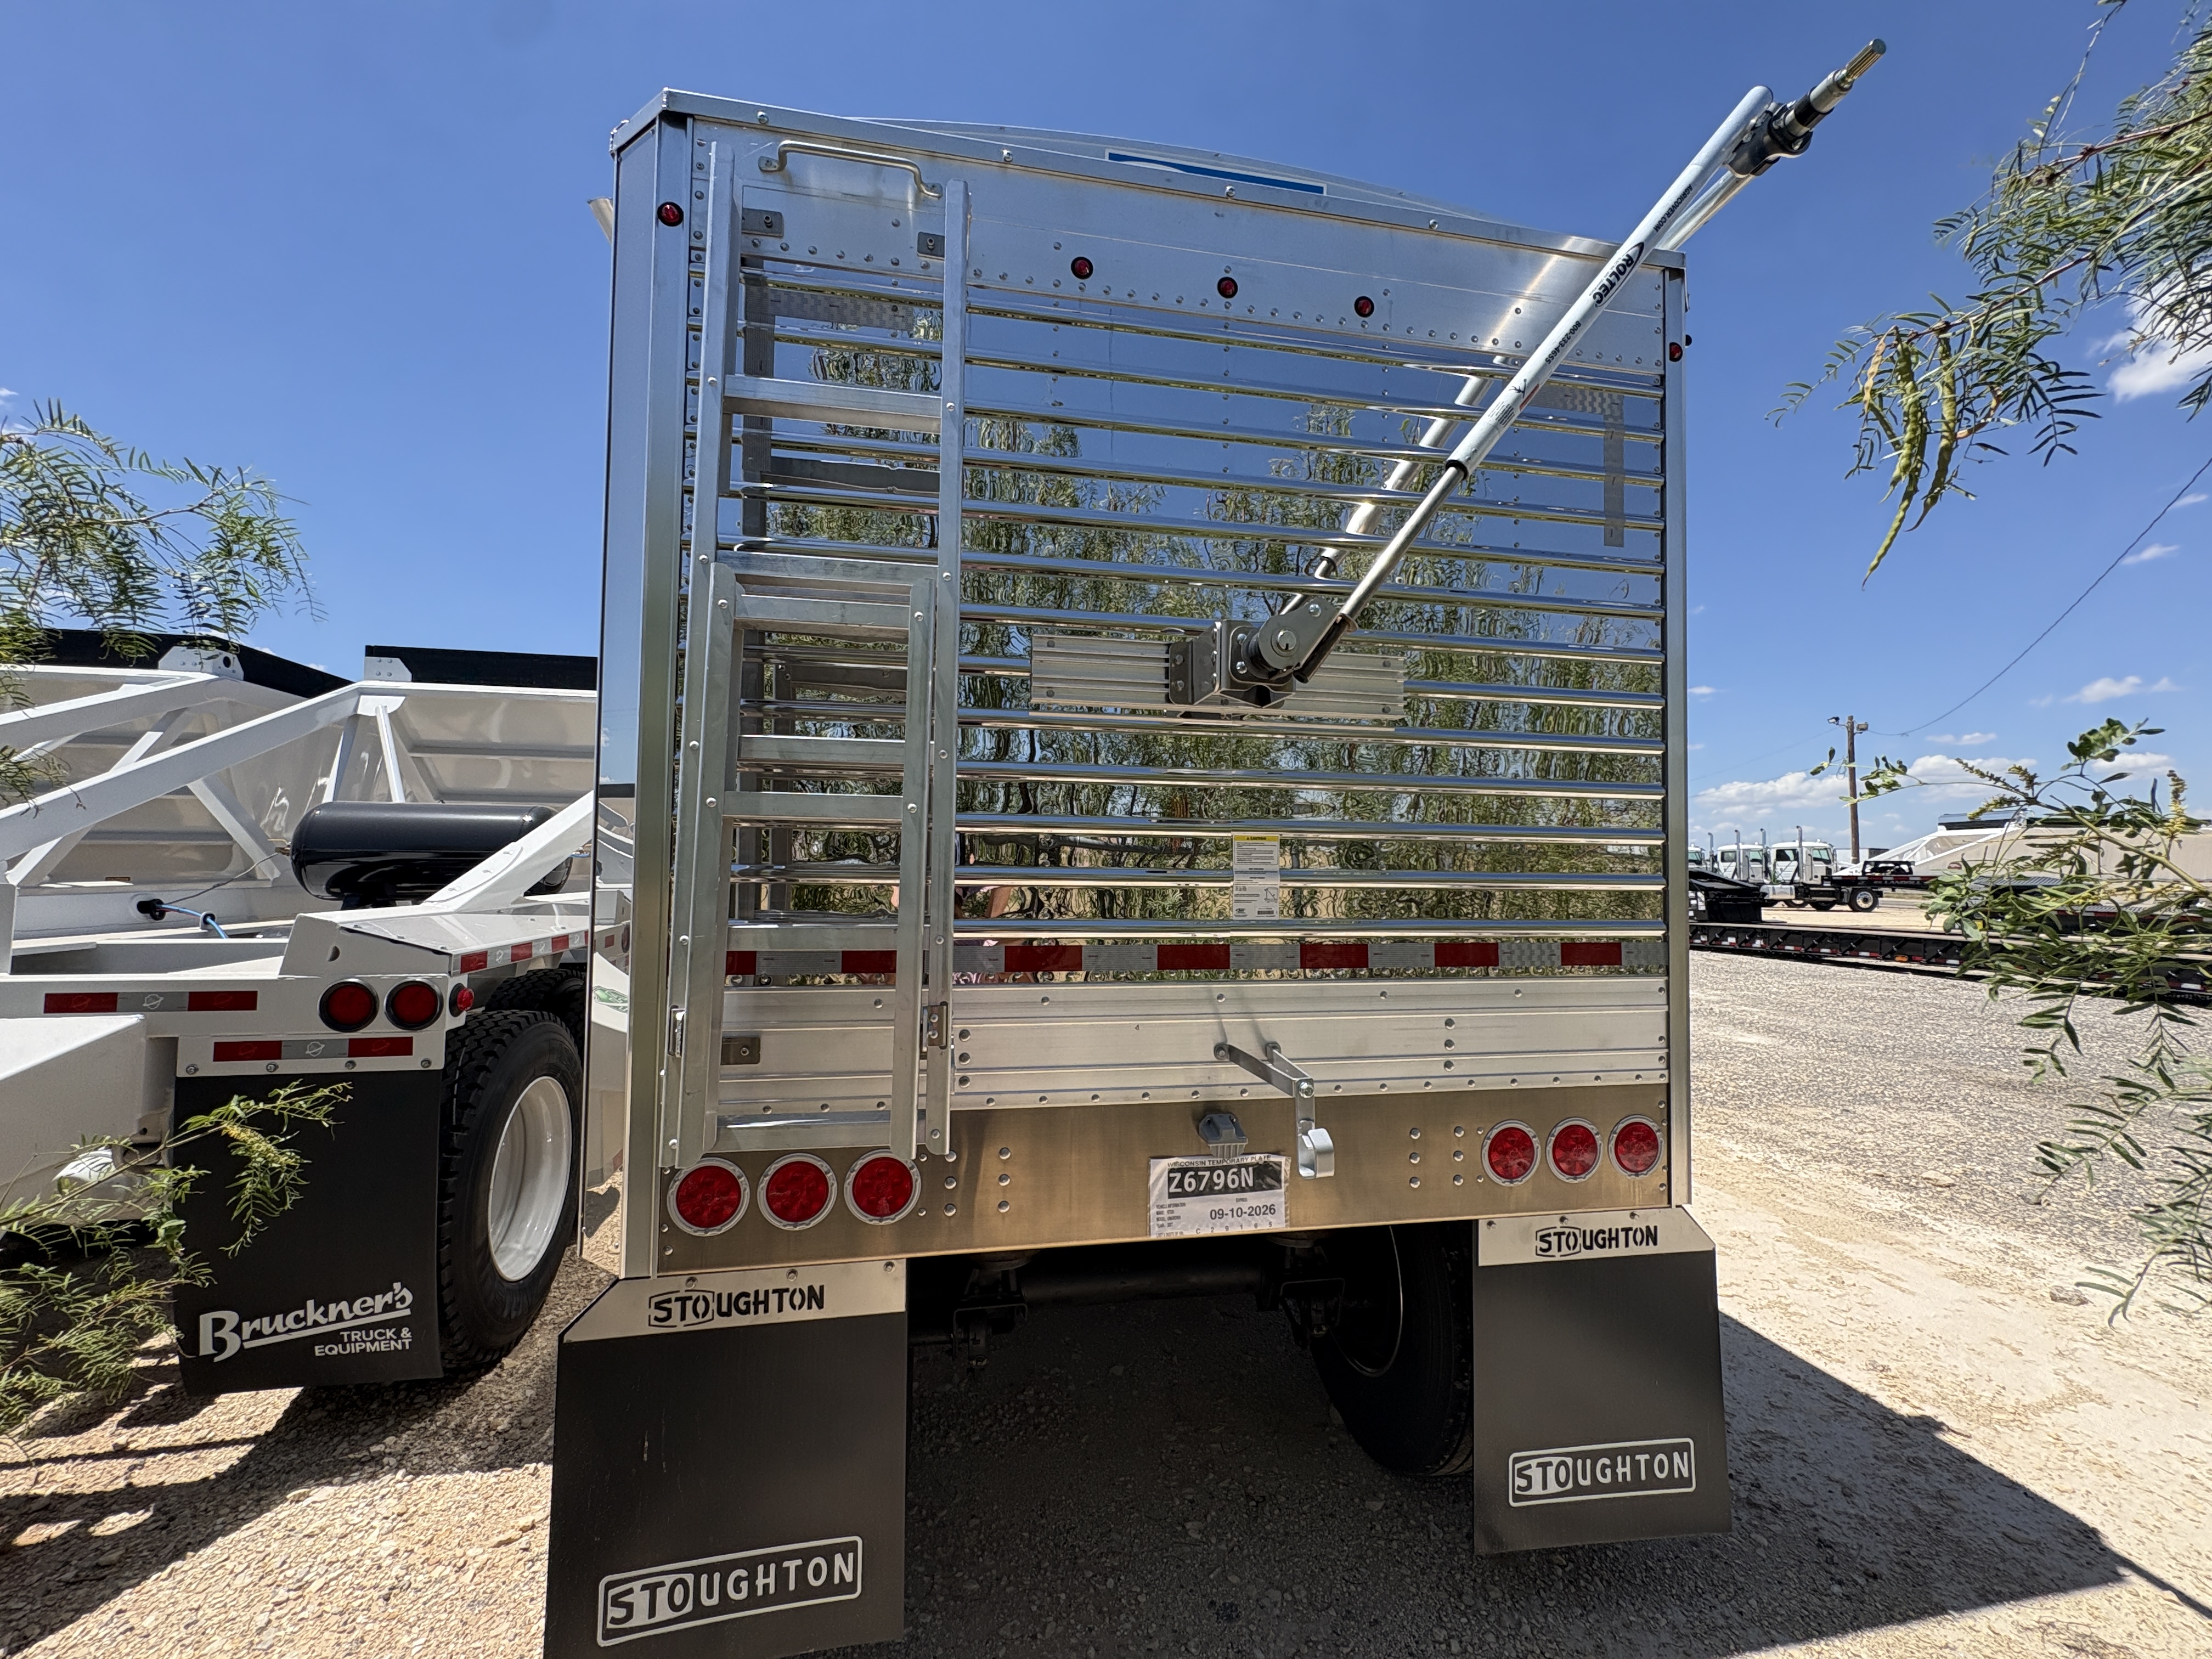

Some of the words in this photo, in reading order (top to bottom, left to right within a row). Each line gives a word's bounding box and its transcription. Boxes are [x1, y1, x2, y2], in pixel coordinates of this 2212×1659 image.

[1654, 184, 1693, 233] AGRICOVER.COM
[1593, 254, 1634, 304] ROLTEC
[1545, 320, 1582, 365] 800-233-4655
[1169, 1167, 1254, 1193] Z6796N
[1207, 1157, 1249, 1166] TEMPORARY
[1210, 1204, 1276, 1220] 09-10-2026
[1539, 1225, 1658, 1253] STOUGHTON
[199, 1282, 413, 1363] Bruckner's
[653, 1284, 825, 1323] STOUGHTON
[314, 1339, 413, 1357] EQUIPMENT
[340, 1328, 398, 1342] TRUCK
[400, 1327, 413, 1339] &
[1516, 1451, 1689, 1493] STOUGHTON
[608, 1552, 854, 1626] STOUGHTON
